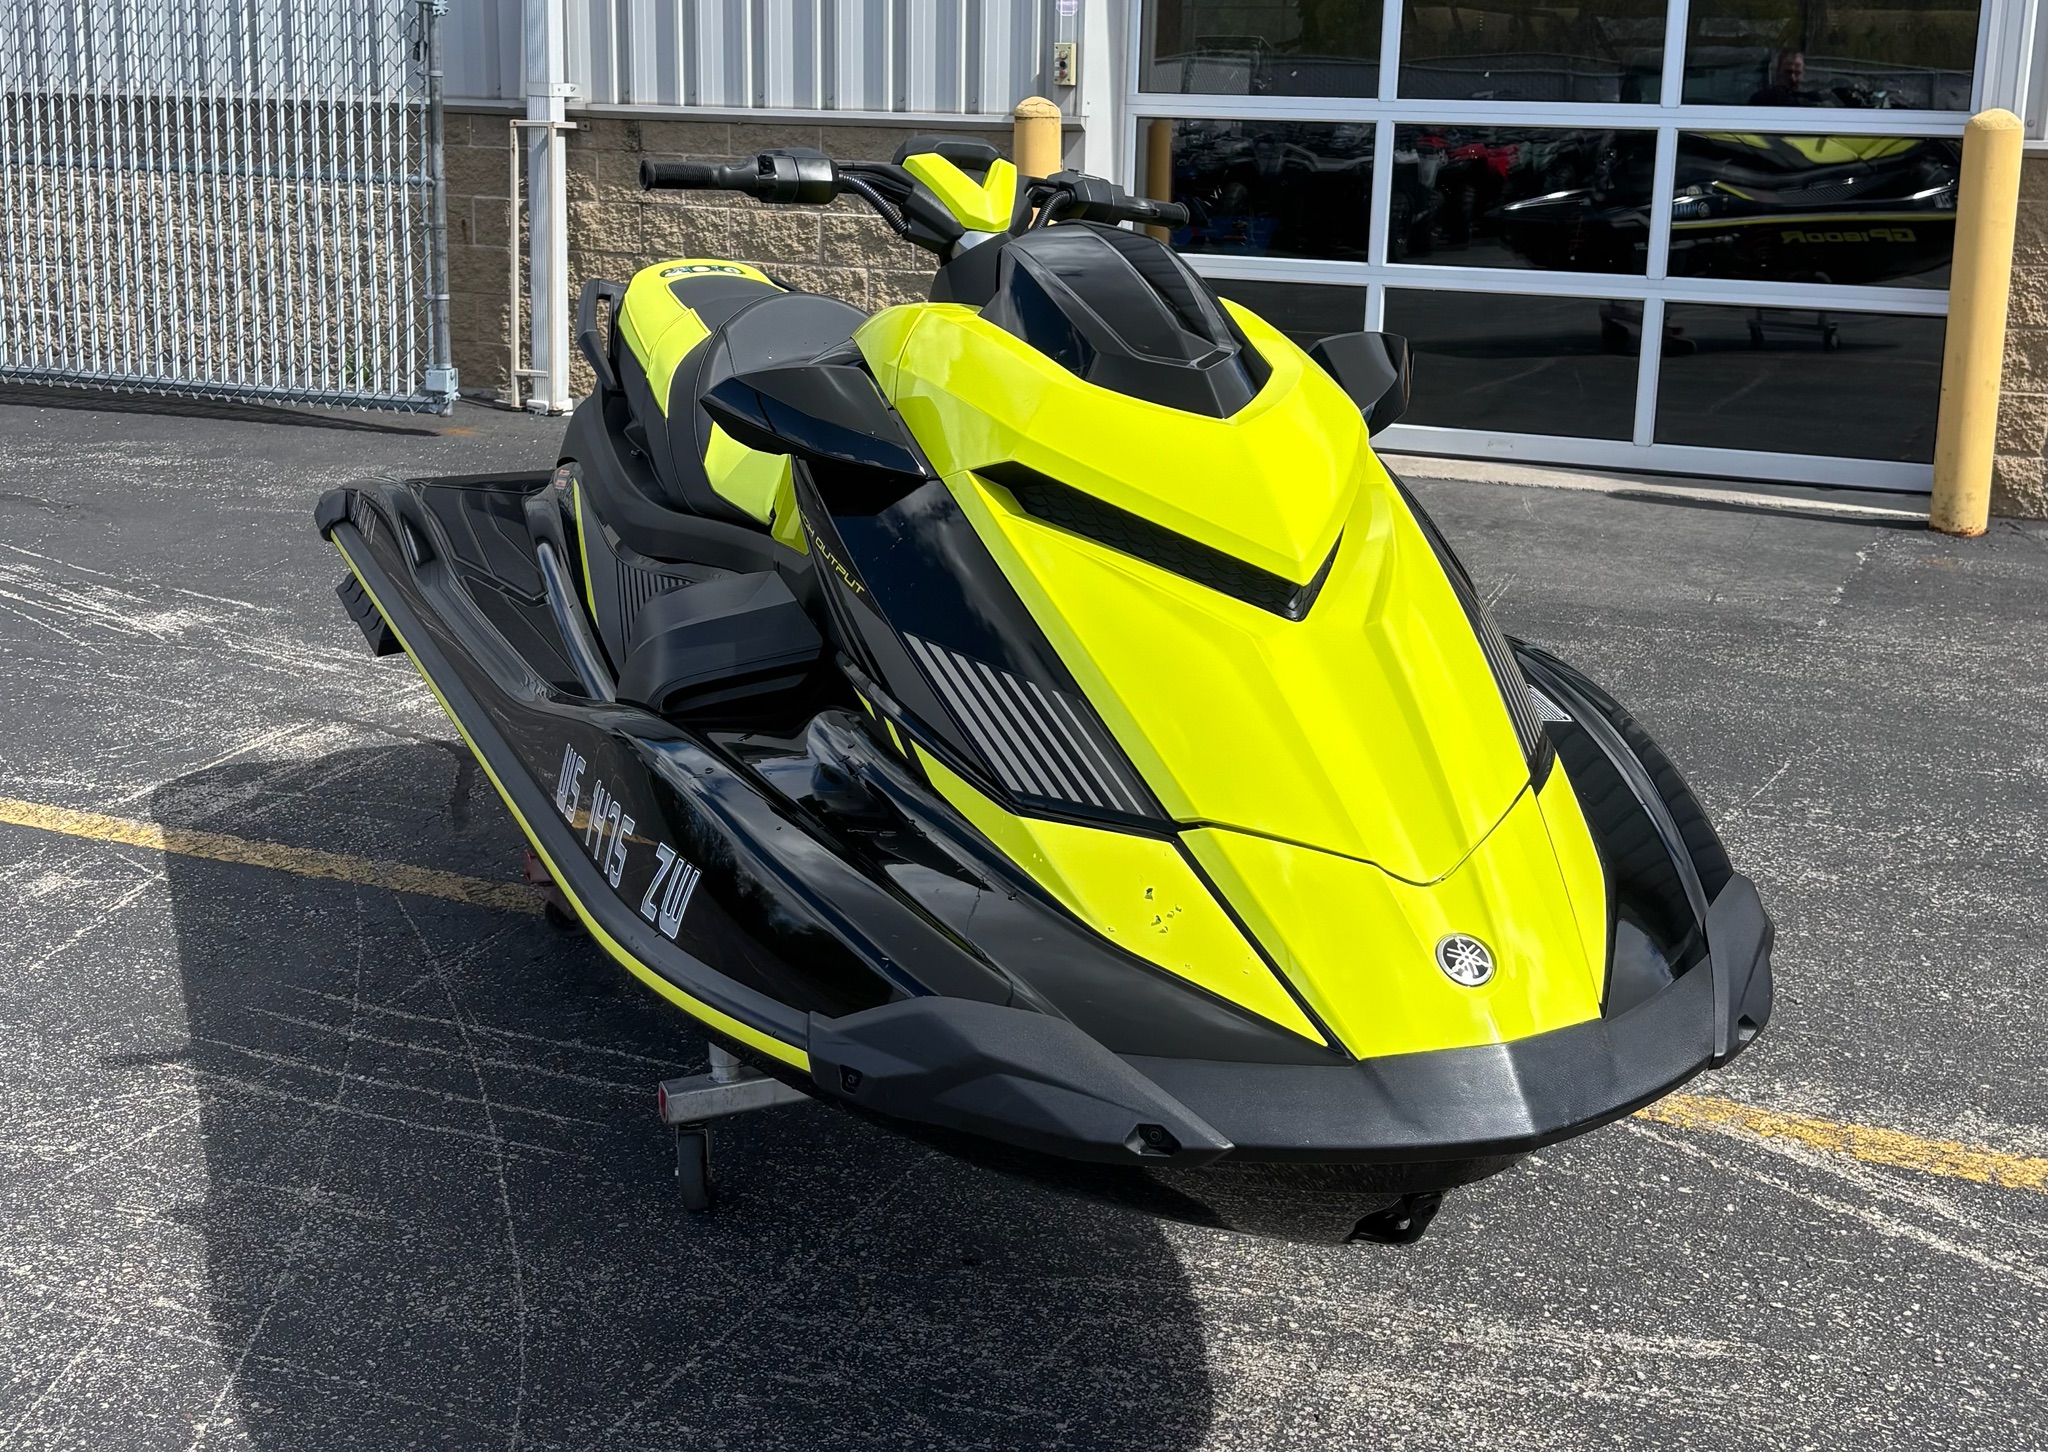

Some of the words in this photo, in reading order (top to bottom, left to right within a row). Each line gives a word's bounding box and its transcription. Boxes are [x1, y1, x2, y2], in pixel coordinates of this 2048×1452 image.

[815, 536, 865, 593] OUTPUT
[585, 779, 636, 889] 1475
[640, 842, 703, 940] ZW
